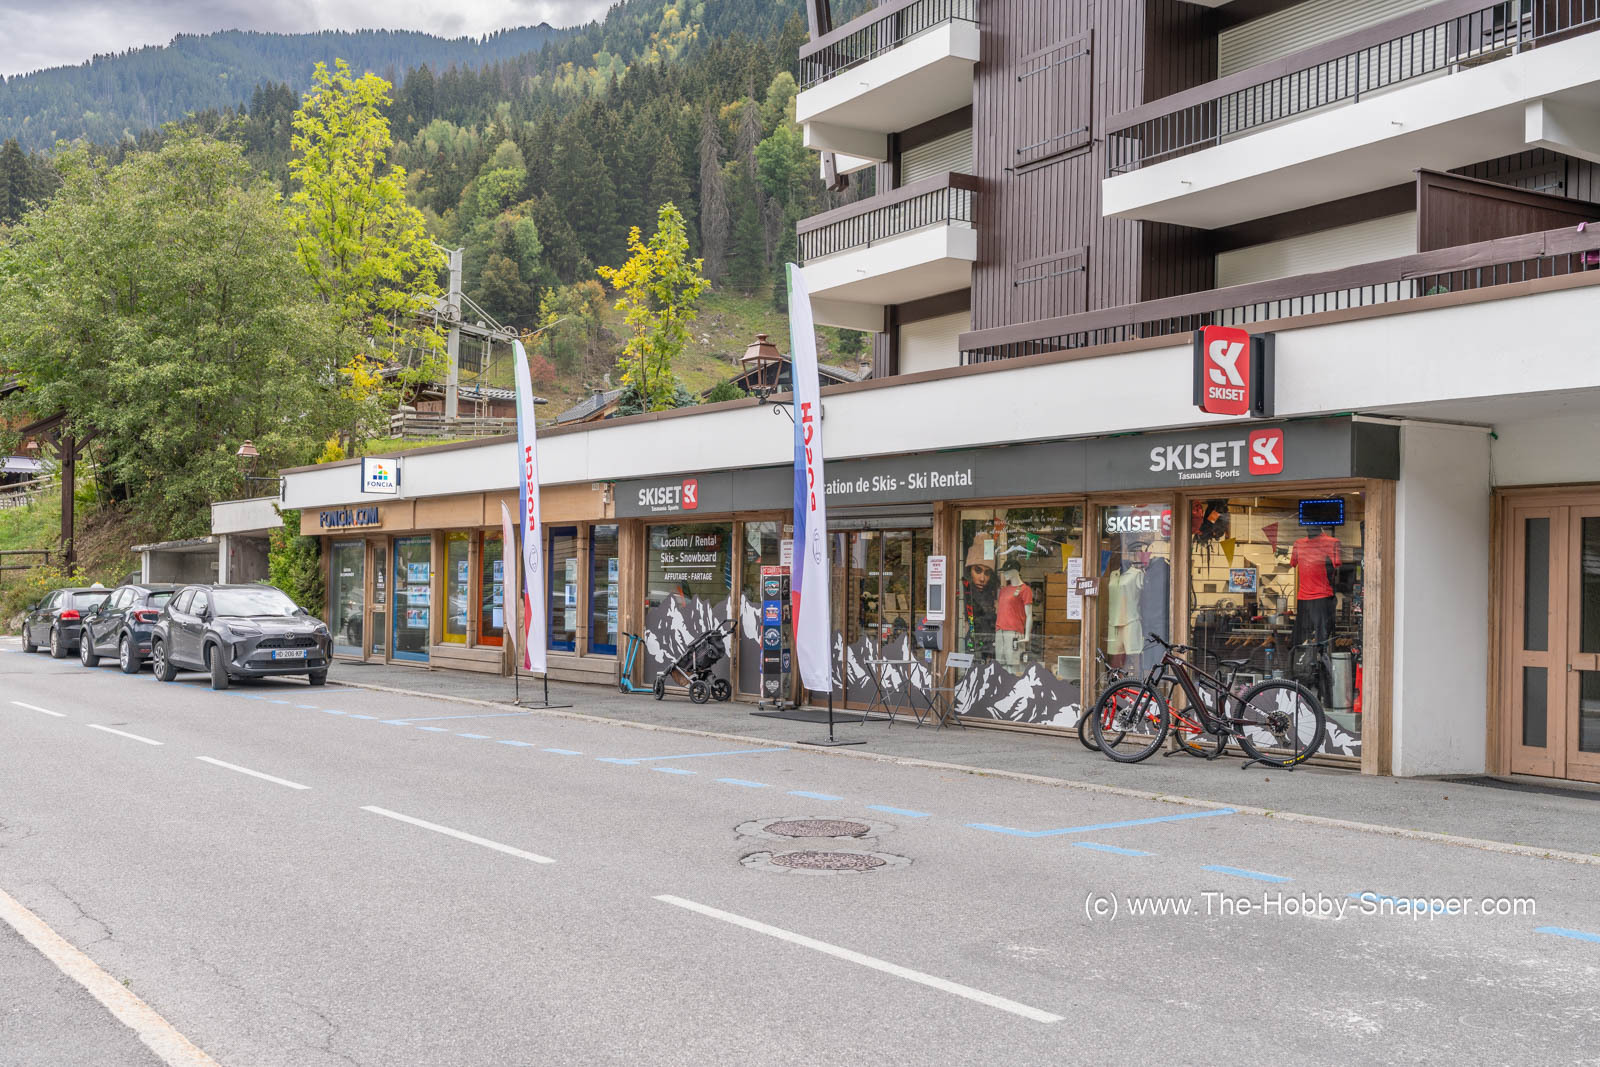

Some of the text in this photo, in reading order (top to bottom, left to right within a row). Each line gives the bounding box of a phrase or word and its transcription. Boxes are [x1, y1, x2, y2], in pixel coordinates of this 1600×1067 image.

[1209, 387, 1245, 401] SKISET
[1150, 440, 1246, 472] SKISET
[856, 477, 870, 493] de
[872, 475, 897, 492] Skis
[908, 472, 927, 490] Ski
[930, 469, 972, 488] Rental
[1178, 469, 1240, 480] Tasmania Sports
[638, 485, 682, 506] SKISET
[320, 506, 379, 528] FONCIA.COM
[1107, 515, 1160, 532] SKISET
[660, 536, 688, 548] Location
[695, 535, 717, 547] Rental
[660, 552, 674, 563] Skis
[680, 552, 717, 563] Snowboard
[664, 573, 688, 581] AFFUTAGE
[691, 572, 713, 581] FARTAGE
